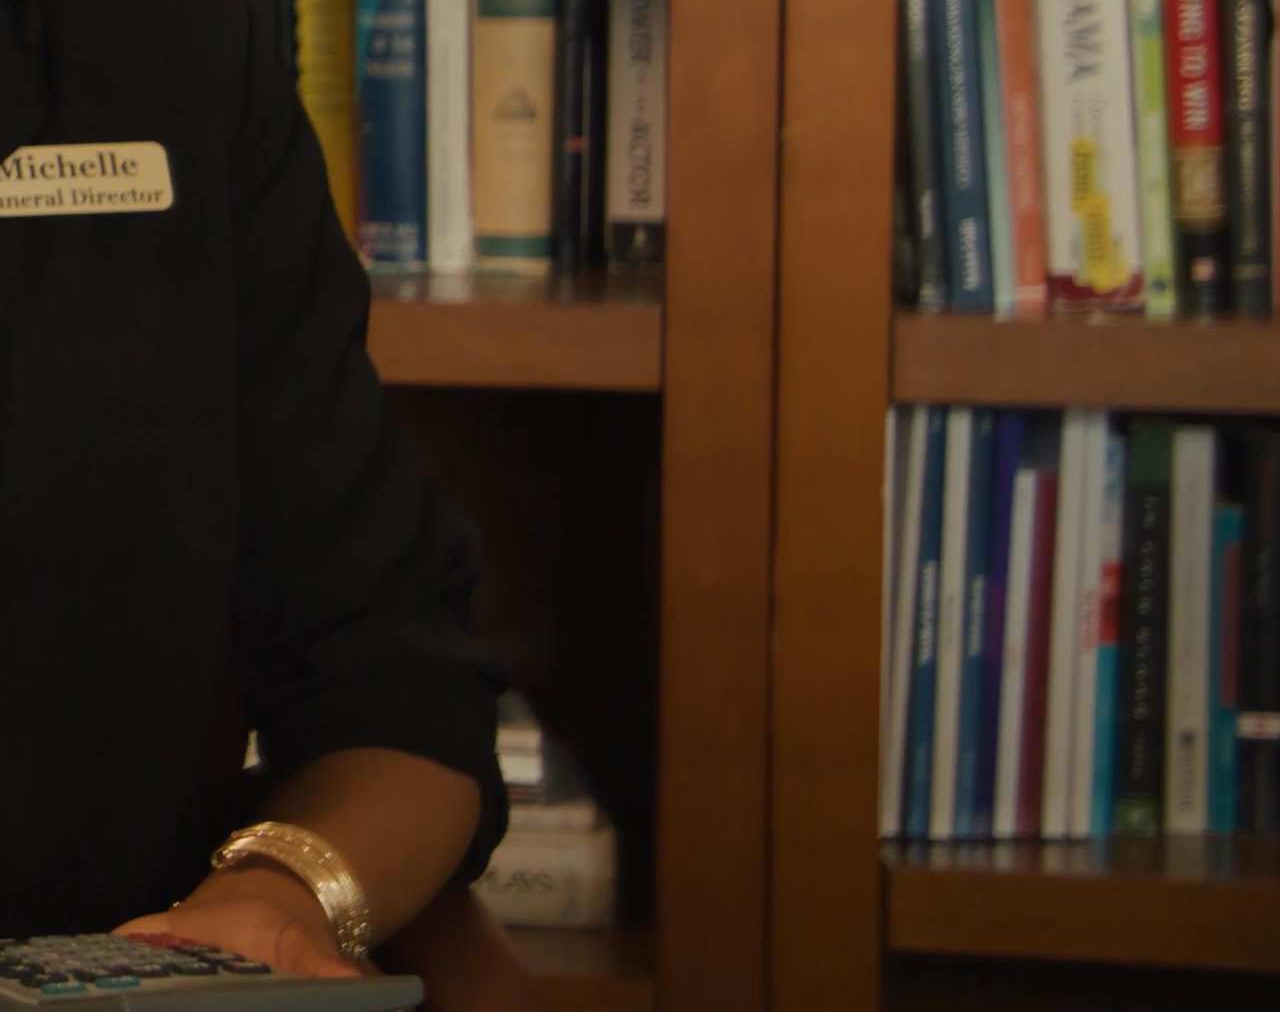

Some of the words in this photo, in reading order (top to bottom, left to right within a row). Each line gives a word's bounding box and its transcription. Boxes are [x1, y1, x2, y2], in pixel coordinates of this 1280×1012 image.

[1179, 43, 1208, 78] TO
[1181, 81, 1211, 131] WIN
[71, 187, 164, 206] Director
